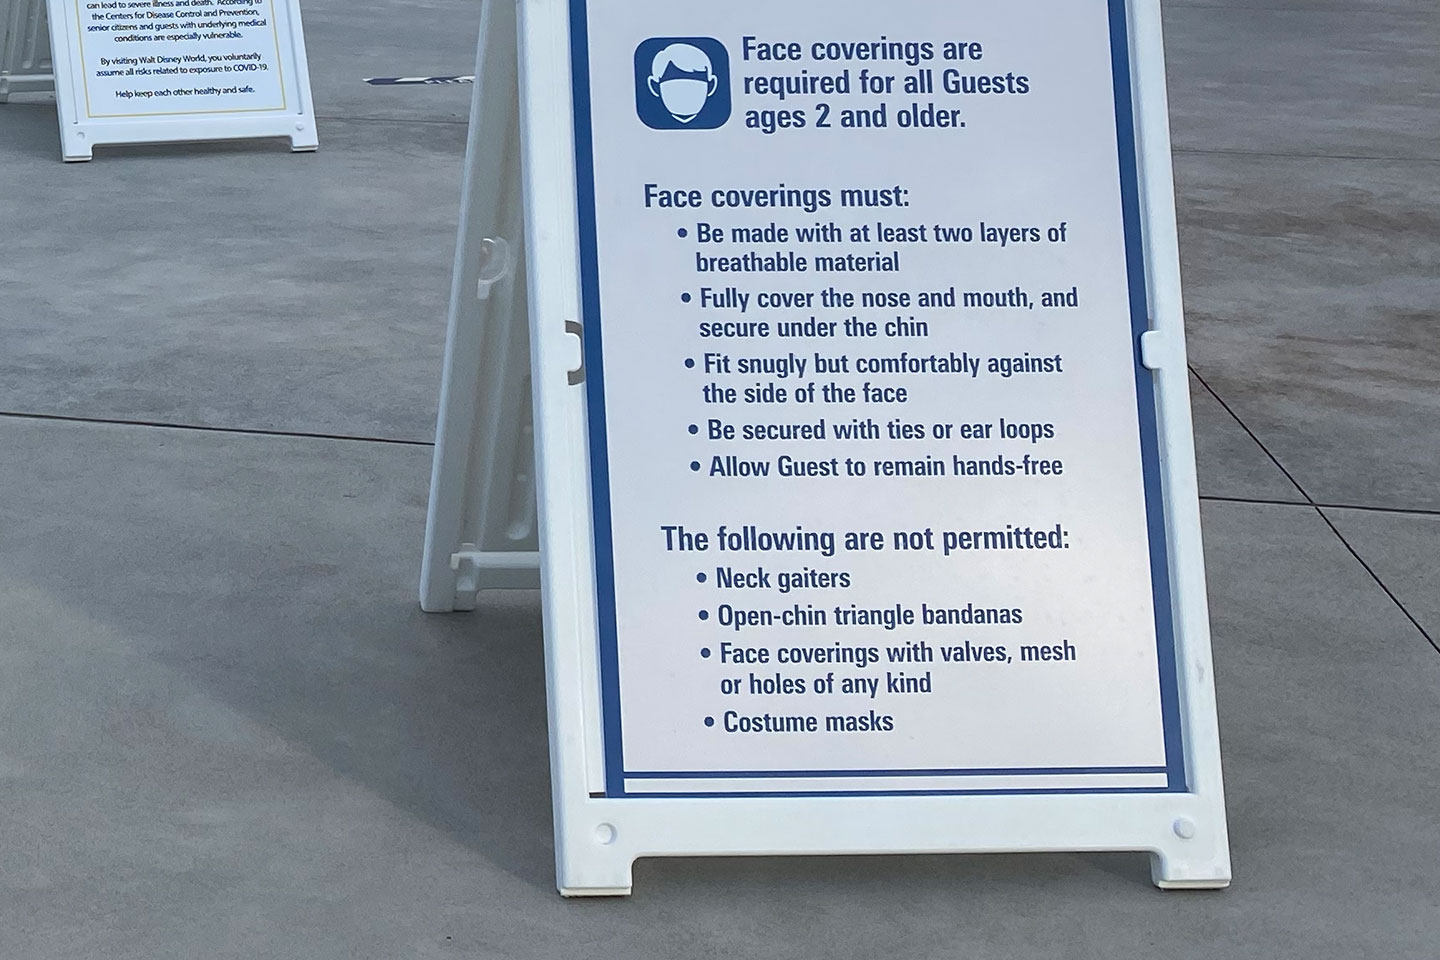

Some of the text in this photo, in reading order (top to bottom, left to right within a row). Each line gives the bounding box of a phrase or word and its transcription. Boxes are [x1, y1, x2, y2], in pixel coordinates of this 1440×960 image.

[742, 36, 983, 66] Face coverings are
[115, 85, 255, 99] Help keep each other healthy and safe.
[744, 68, 1030, 100] required for all Guests
[745, 102, 966, 134] ages 2 and older.
[644, 183, 909, 213] Face coverings must:
[696, 221, 1067, 247] Be made with at least two layers of
[695, 250, 899, 272] breathable material
[700, 286, 1078, 313] Fully cover the nose and mouth, and
[699, 315, 928, 338] secure under the chin
[703, 351, 1063, 378] Fit snugly but comfortably against
[702, 381, 908, 403] the side of the face
[707, 417, 1055, 444] Be secured with ties or ear loops
[709, 454, 1063, 477] Allow Guest to remain hands-free
[660, 523, 1069, 557] The following are not permitted:
[716, 566, 851, 593] Neck gaiters
[717, 602, 1023, 631] Open-chin triangle bandanas
[720, 639, 1076, 668] Face coverings with valves, mesh
[720, 671, 932, 699] or holes of any kind
[723, 709, 894, 733] Costume masks
